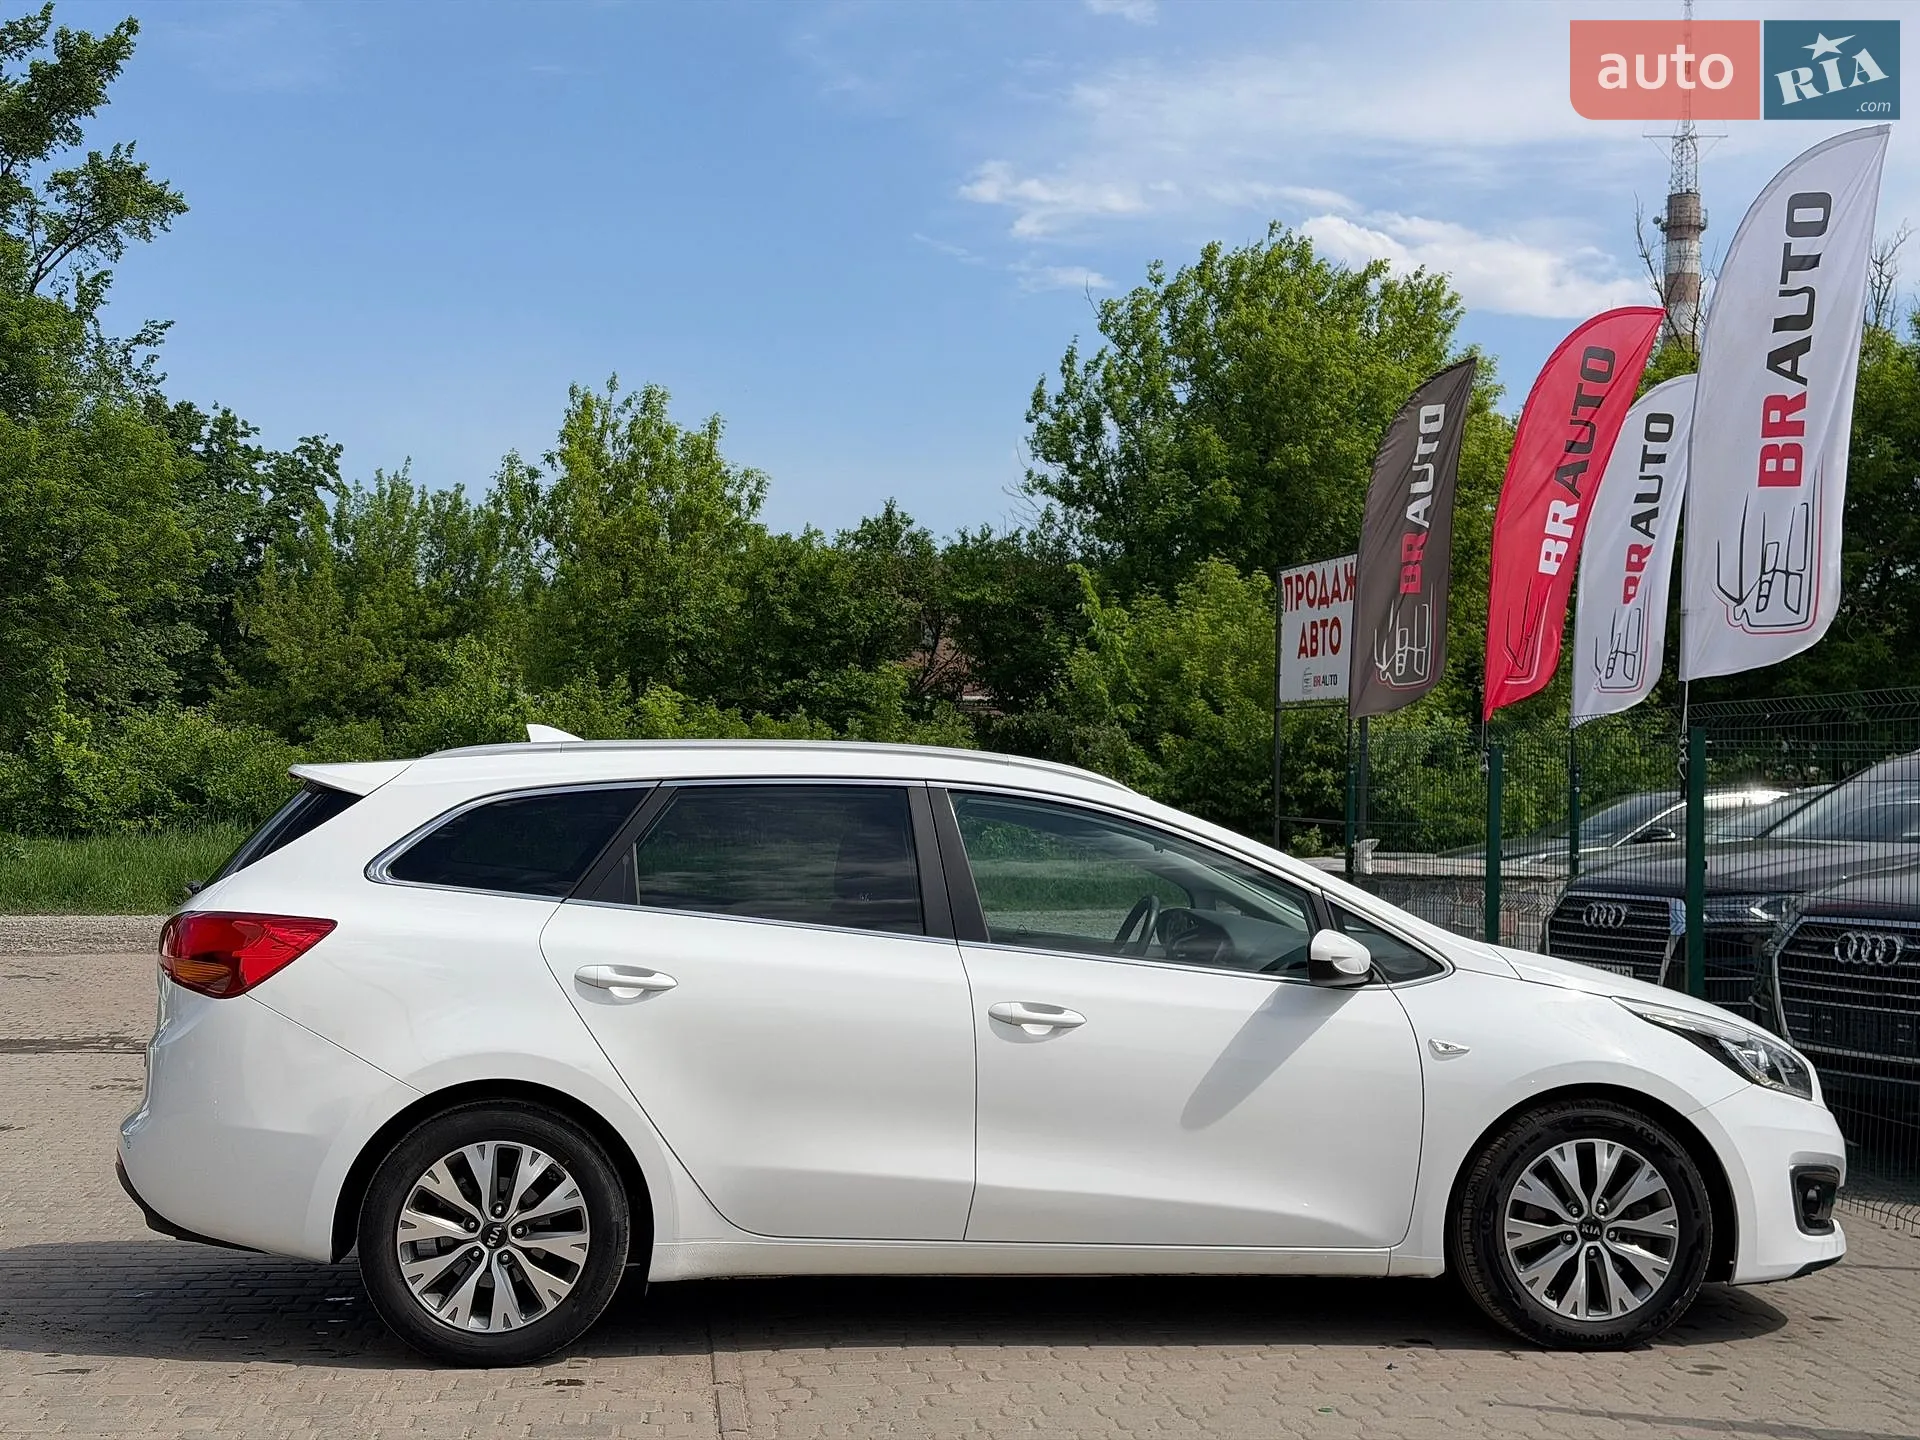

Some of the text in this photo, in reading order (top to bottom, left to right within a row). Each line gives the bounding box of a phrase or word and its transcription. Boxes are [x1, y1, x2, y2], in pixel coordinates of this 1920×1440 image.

[1757, 190, 1833, 488] BRAUTO
[1399, 403, 1446, 595] BRAUTO
[1538, 346, 1616, 576] BRAUTO
[1297, 616, 1342, 659] АВТО
[487, 1227, 502, 1247] KIA
[1581, 1223, 1601, 1236] KIA
